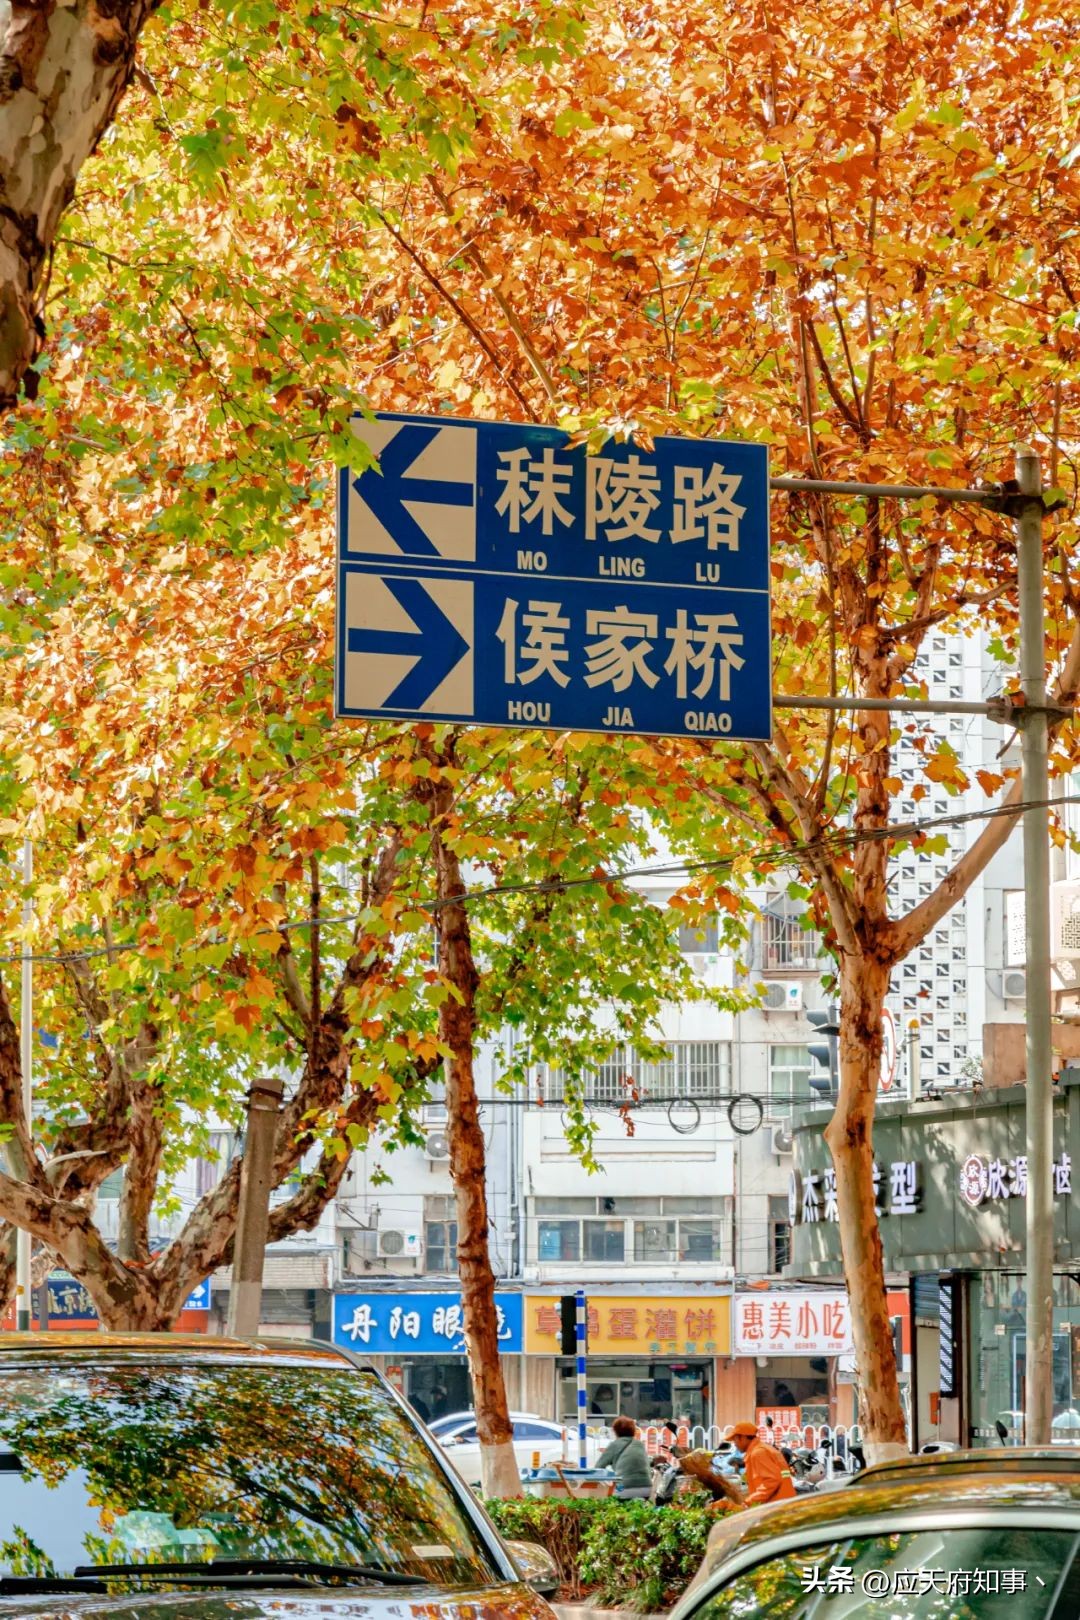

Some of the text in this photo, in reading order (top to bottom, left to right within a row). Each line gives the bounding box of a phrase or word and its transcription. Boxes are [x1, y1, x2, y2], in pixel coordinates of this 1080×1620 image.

[494, 447, 746, 551] 秣陵路
[517, 550, 720, 582] MO LING LU
[496, 597, 746, 700] 侯家桥
[508, 700, 732, 733] HOU JIA QIAO
[986, 1152, 1072, 1198] 欣源卤
[742, 1300, 846, 1340] 惠美小吃
